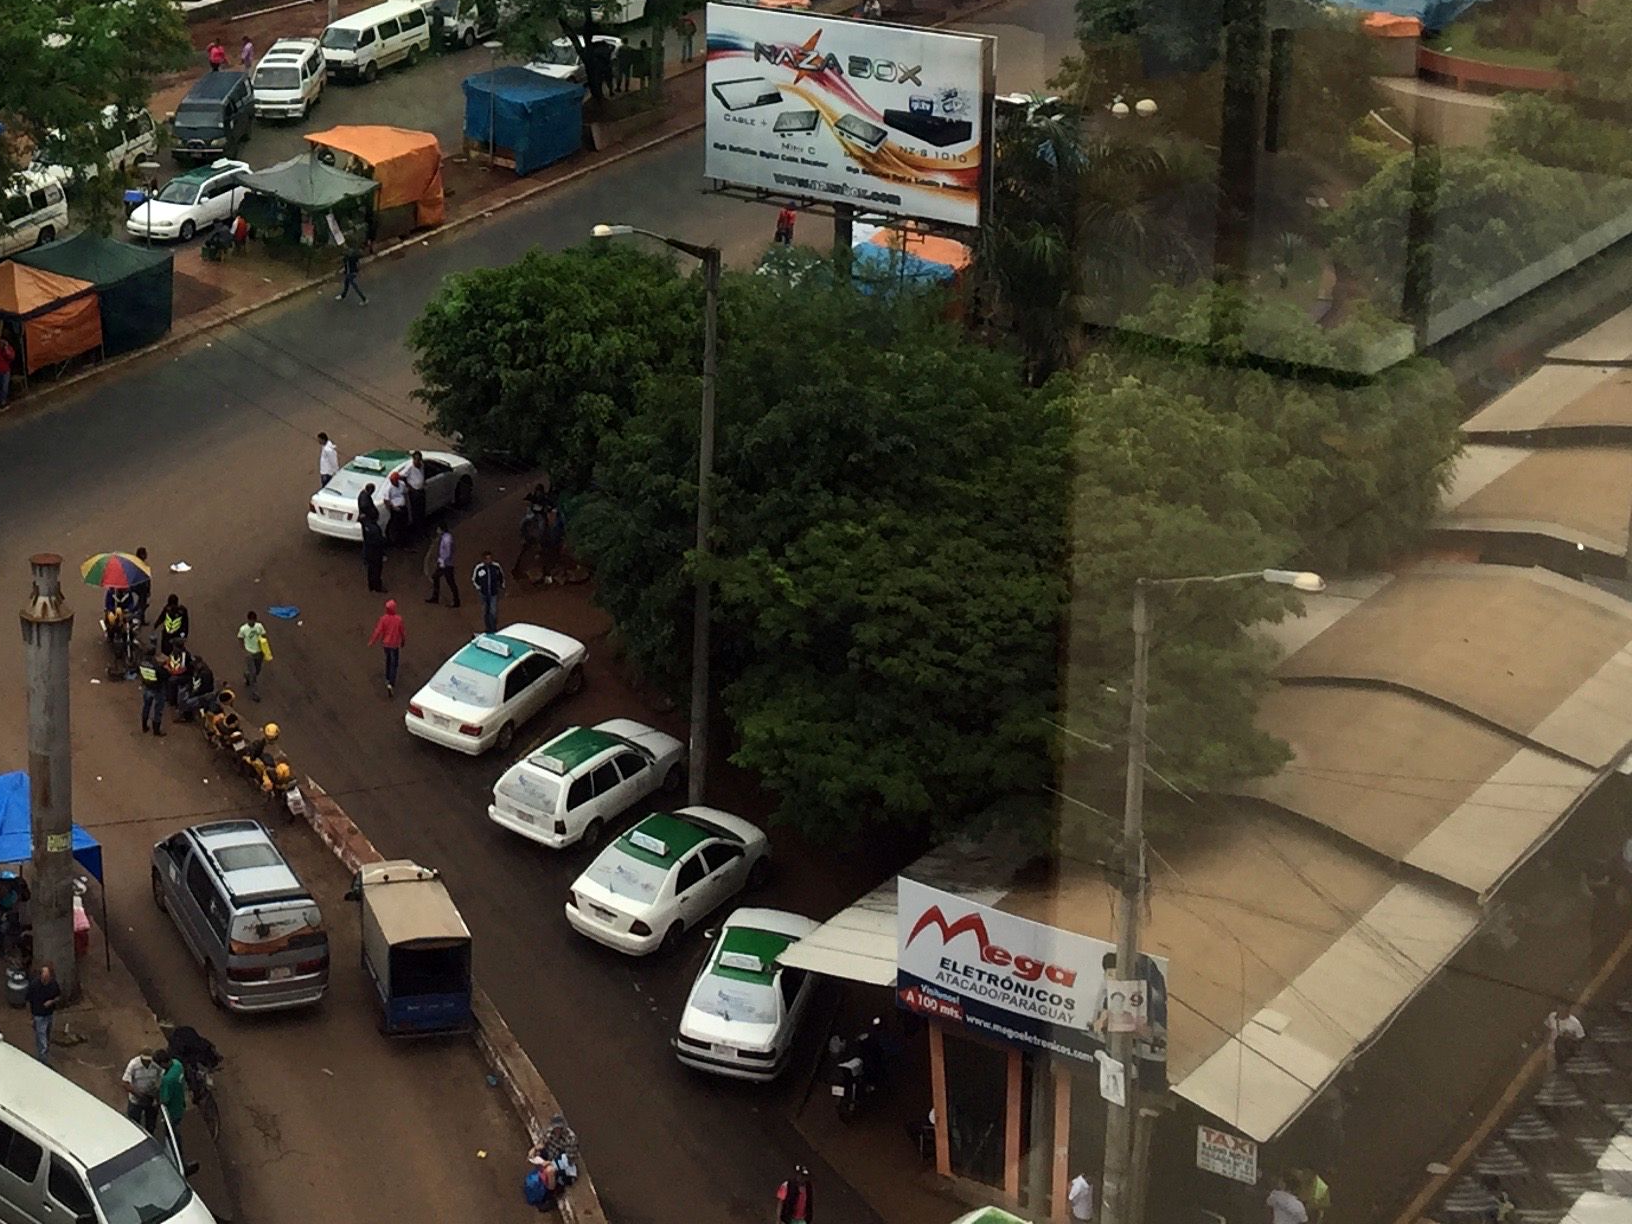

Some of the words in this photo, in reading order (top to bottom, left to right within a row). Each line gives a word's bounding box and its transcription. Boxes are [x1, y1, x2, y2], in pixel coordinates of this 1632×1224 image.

[905, 905, 1077, 988] Mega
[917, 993, 938, 1011] 100
[935, 970, 1075, 1025] ATACADO/PARAGUAY
[939, 956, 1076, 1011] ELETRÔNICOS
[1202, 1127, 1255, 1156] TAXI
